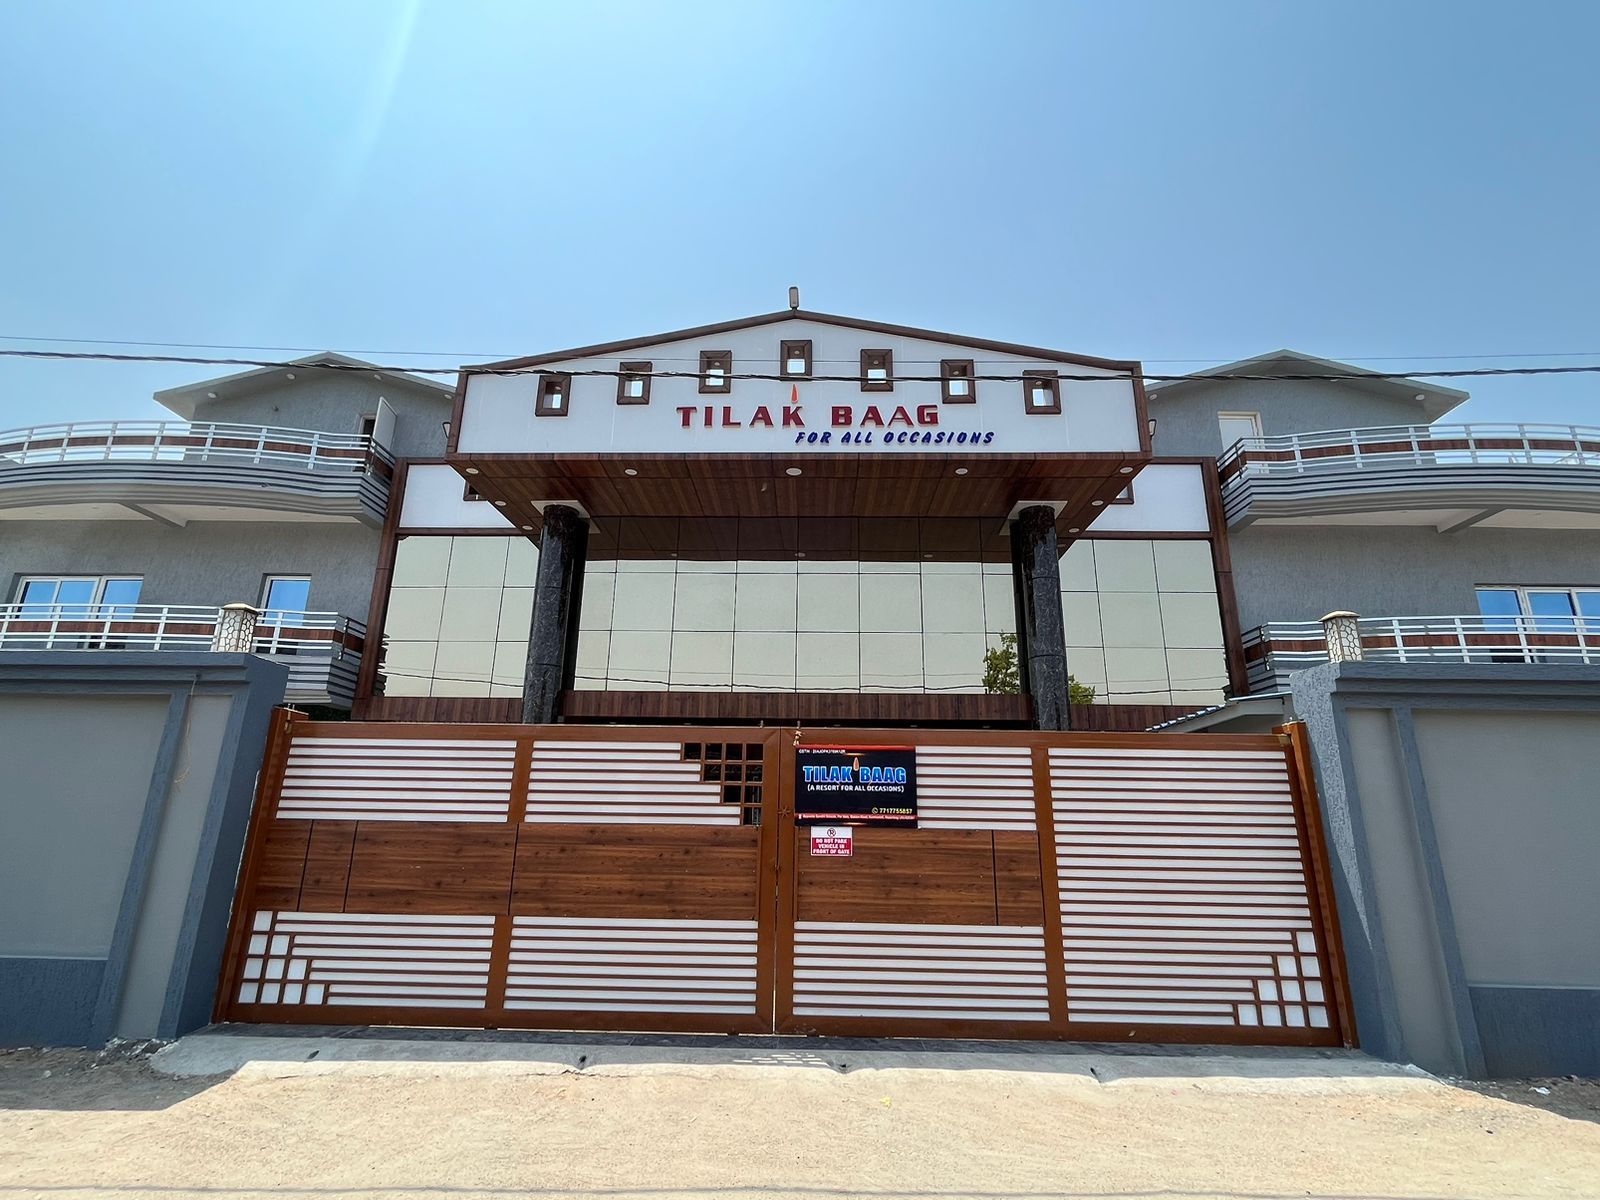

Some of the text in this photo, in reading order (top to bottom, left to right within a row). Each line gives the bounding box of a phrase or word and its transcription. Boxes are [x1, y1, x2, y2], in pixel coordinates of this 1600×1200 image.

[676, 404, 939, 428] TILAK BAAG
[795, 431, 995, 445] FOR ALL OCCASIONS
[803, 765, 907, 784] TILAK BAAG
[866, 785, 904, 793] OCCASIONS)
